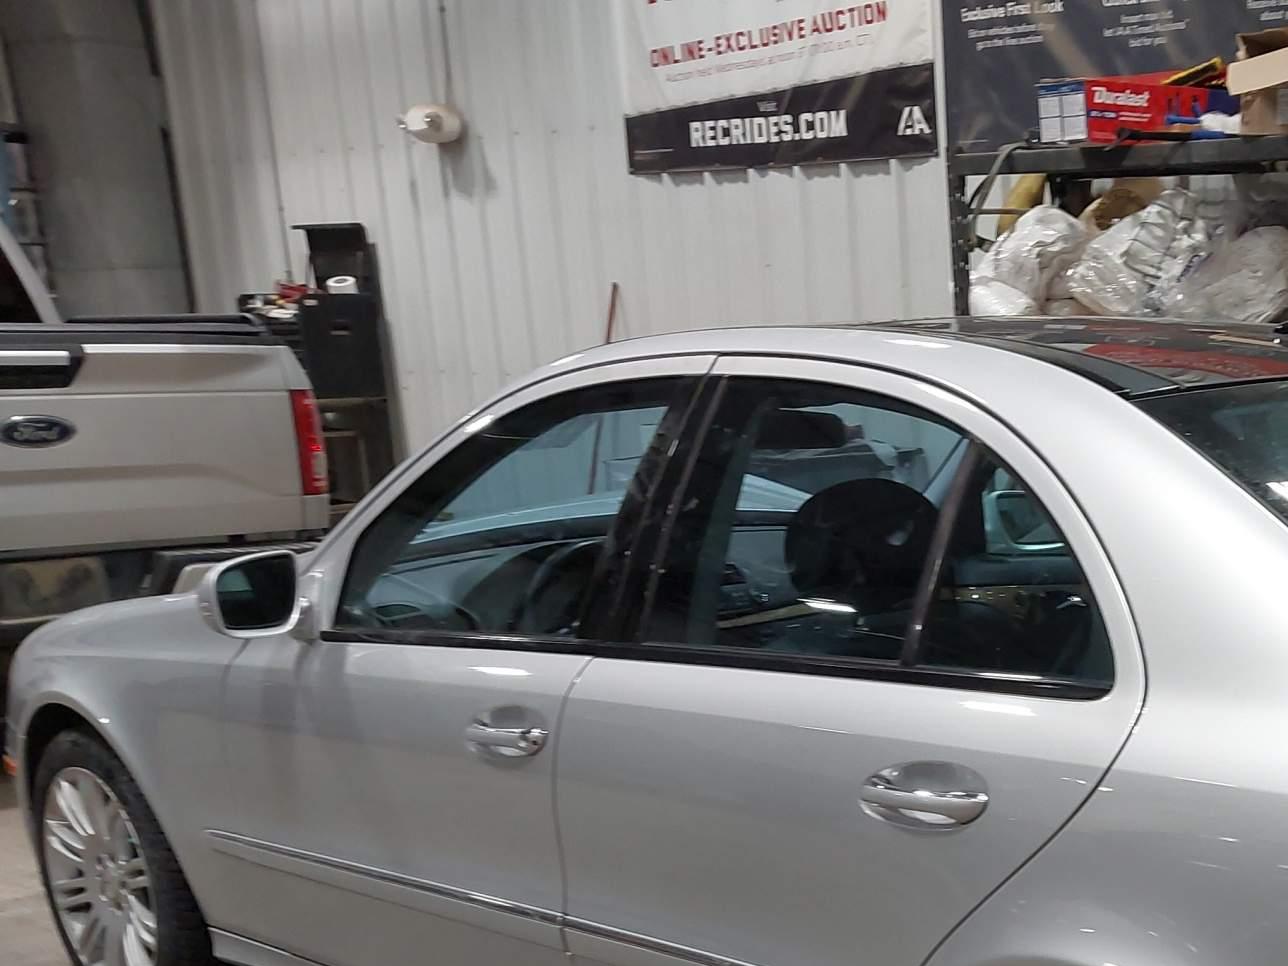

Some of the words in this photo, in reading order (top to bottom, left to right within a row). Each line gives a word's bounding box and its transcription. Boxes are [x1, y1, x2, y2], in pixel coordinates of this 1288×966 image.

[650, 18, 805, 67] ONLINE-EXCLUSIVE
[809, 1, 888, 36] AUCTION
[1091, 86, 1151, 107] Duralast
[689, 109, 849, 148] RECRIDES.COM
